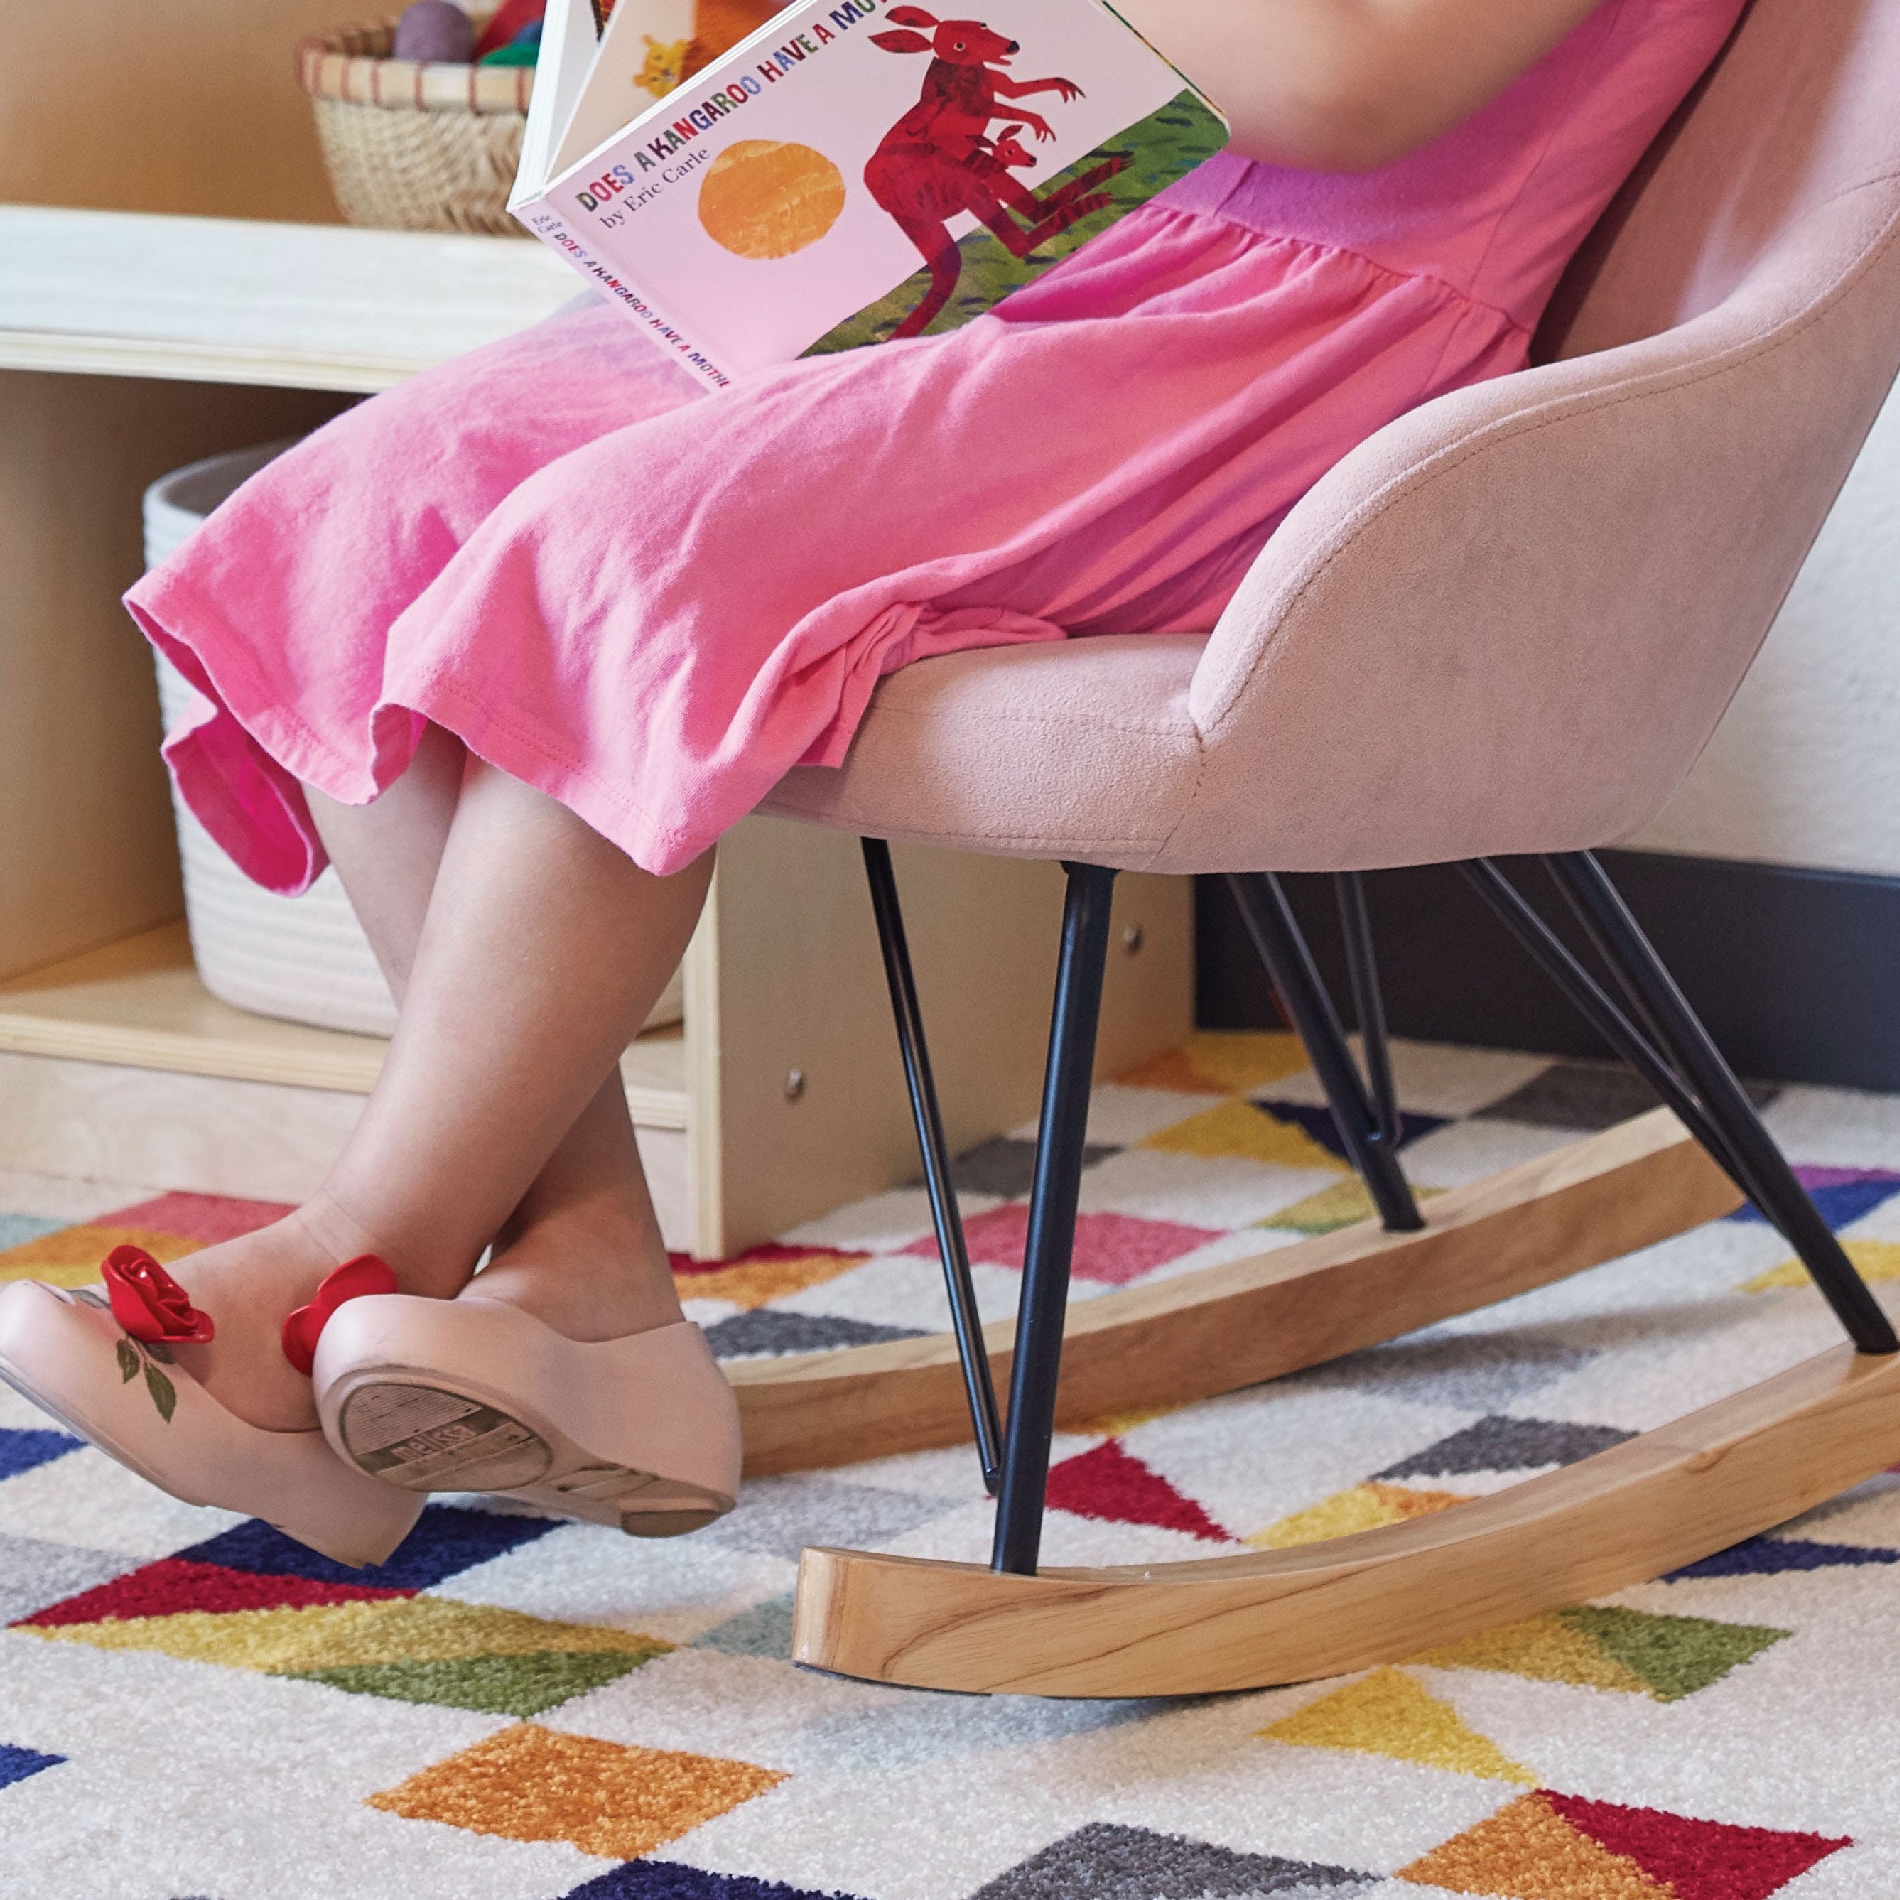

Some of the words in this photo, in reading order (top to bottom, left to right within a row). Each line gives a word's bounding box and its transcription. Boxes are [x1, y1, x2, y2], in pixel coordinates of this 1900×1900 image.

[575, 164, 635, 213] DOES
[633, 151, 657, 172] A
[647, 75, 762, 160] KANGAROO
[756, 33, 819, 83] HAVE
[812, 22, 836, 45] A
[599, 209, 627, 229] by
[623, 183, 664, 212] Eric
[661, 147, 711, 184] Carle
[553, 232, 588, 258] DOES
[582, 260, 597, 268] A
[592, 267, 653, 319] KANGAROO
[649, 318, 684, 345] HAVE
[677, 344, 692, 353] A
